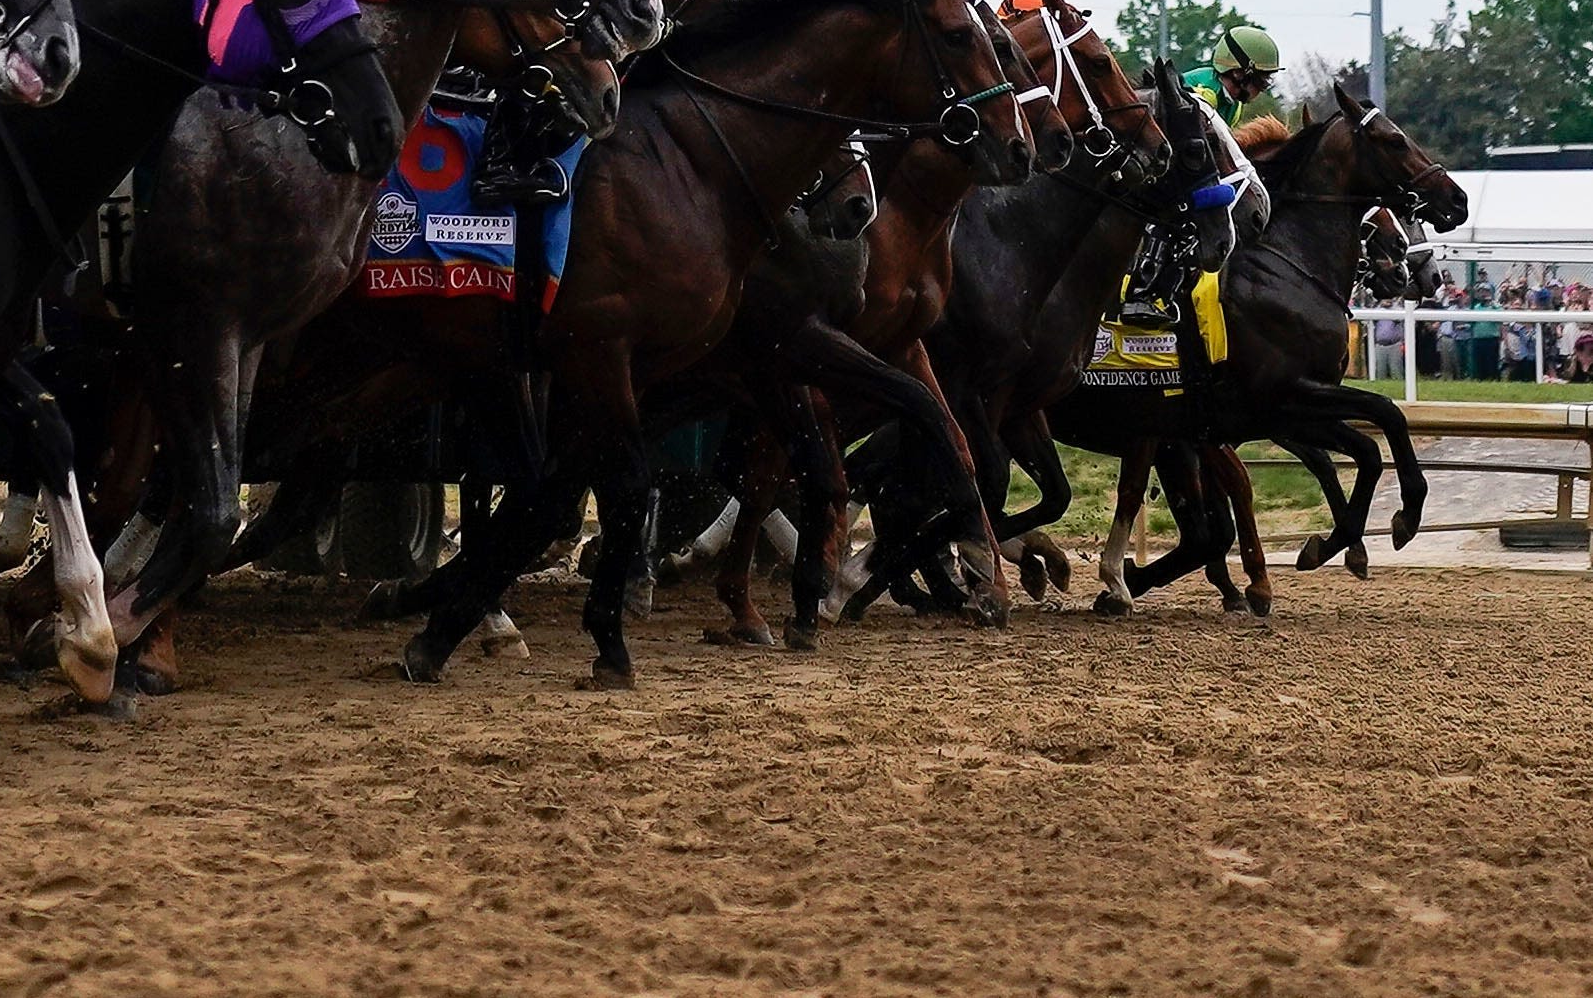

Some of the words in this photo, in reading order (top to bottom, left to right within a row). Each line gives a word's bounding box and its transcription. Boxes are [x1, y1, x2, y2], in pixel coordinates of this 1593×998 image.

[428, 215, 511, 228] WOODFORD
[435, 229, 504, 241] RESERVE
[368, 265, 446, 290] RAISE
[450, 265, 515, 294] CAIN
[1150, 370, 1183, 384] GAME
